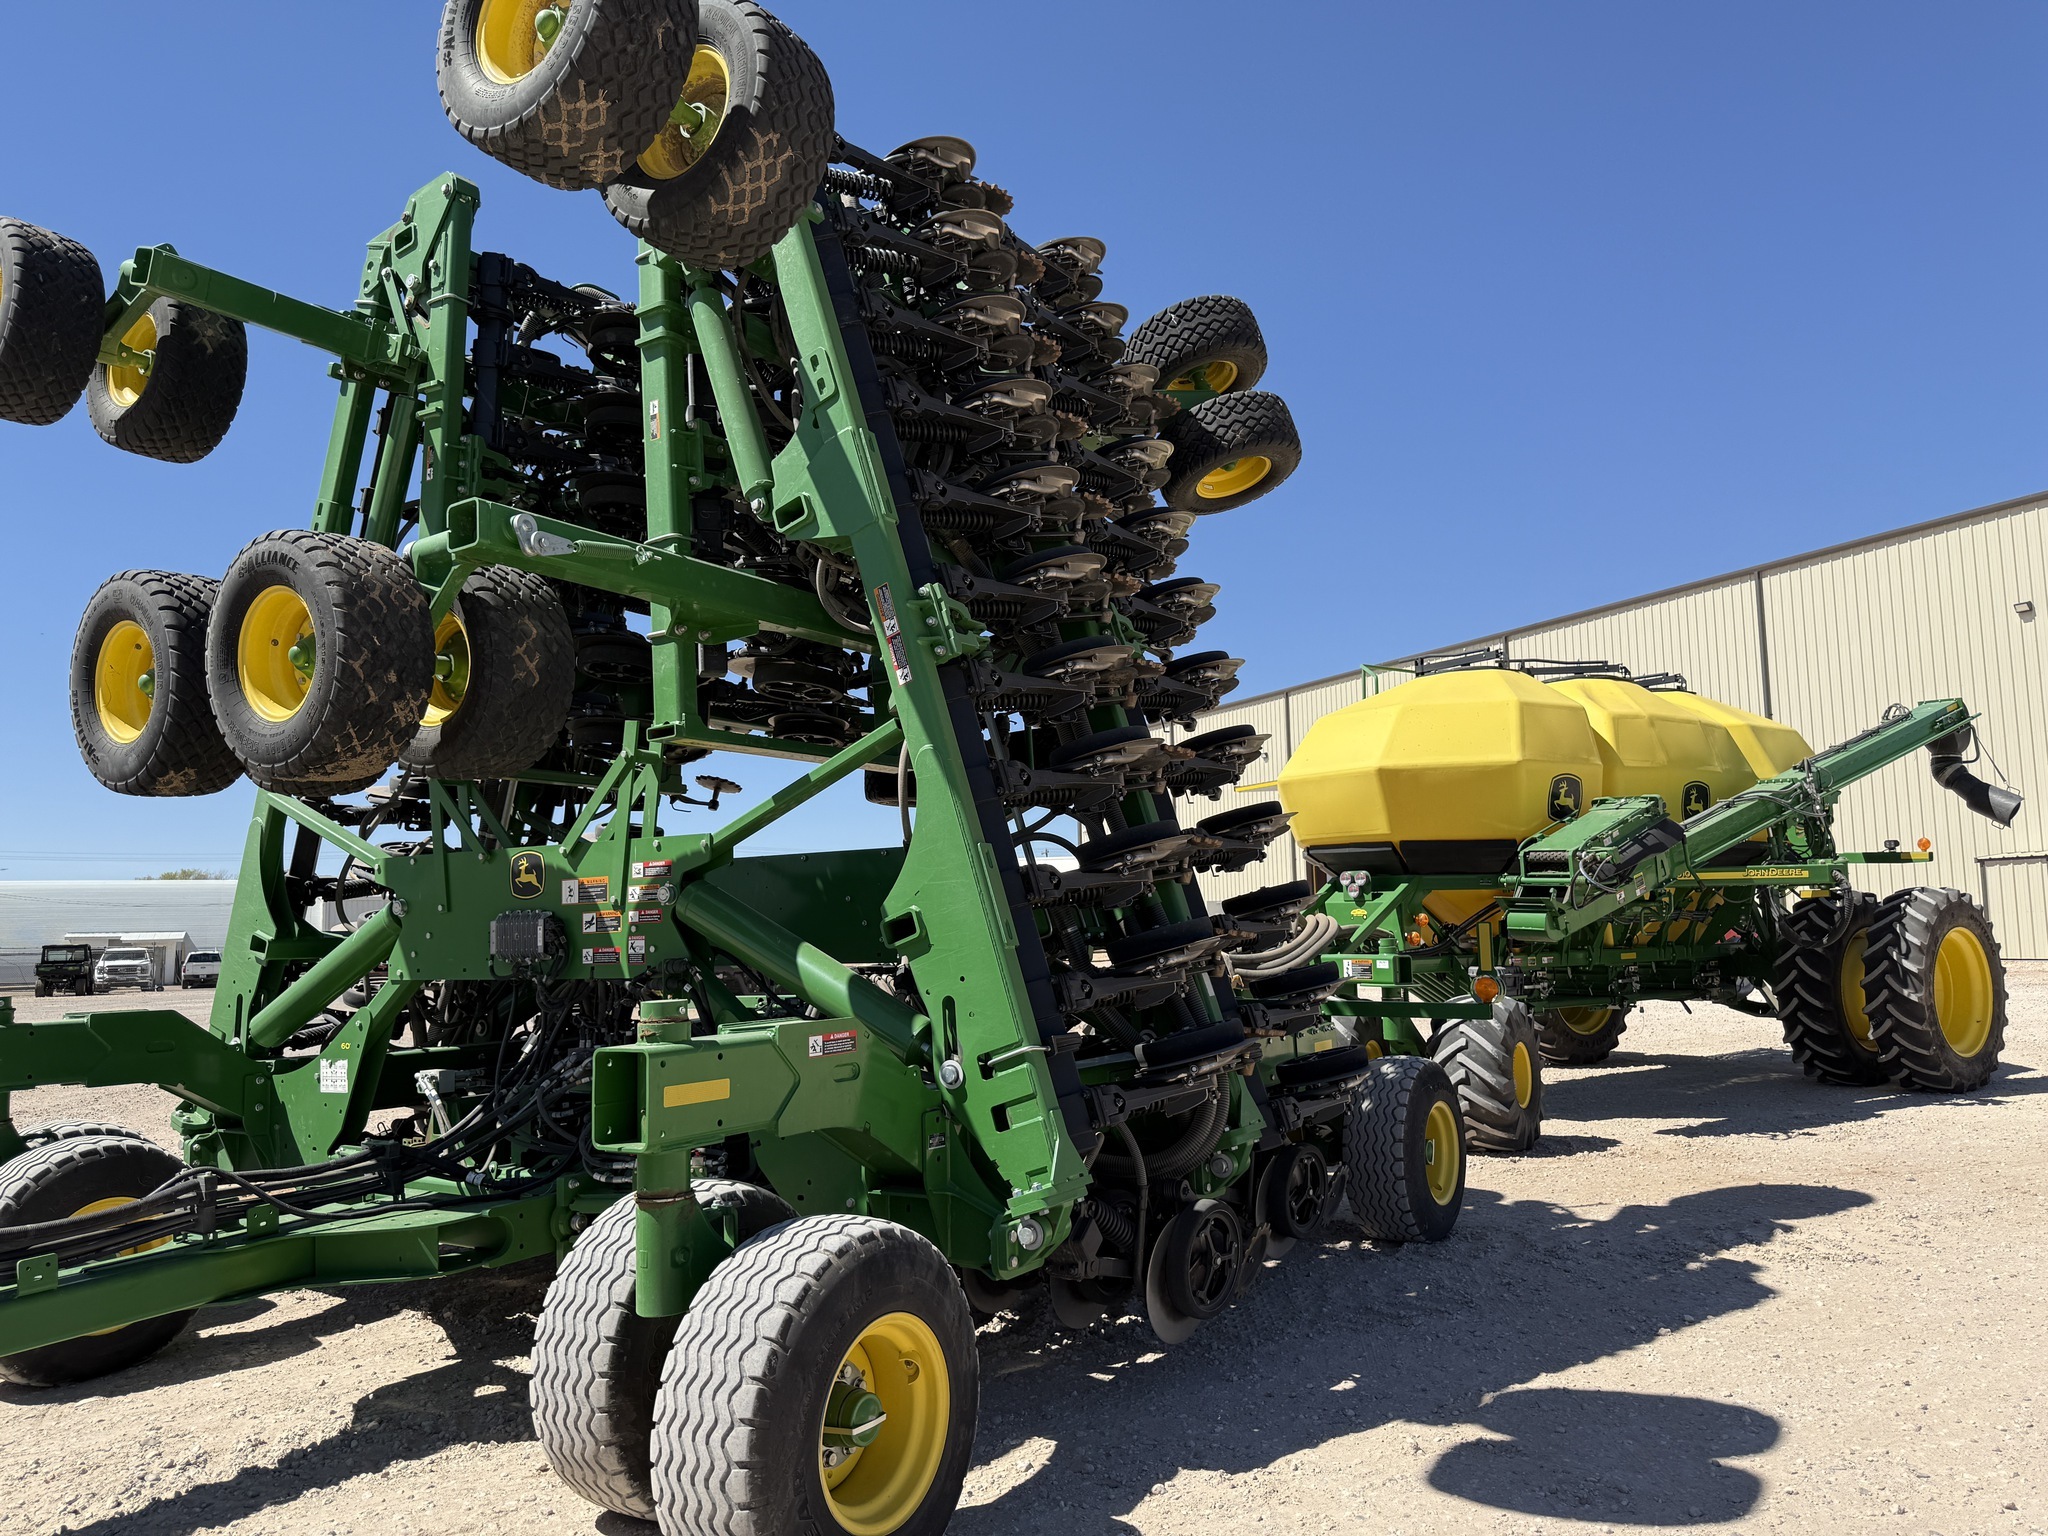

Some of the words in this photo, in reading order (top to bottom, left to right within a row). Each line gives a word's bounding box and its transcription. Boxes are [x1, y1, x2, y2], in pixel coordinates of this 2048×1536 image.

[248, 551, 300, 575] ALLIANCE
[1742, 868, 1769, 877] JOHN
[1769, 868, 1803, 877] DEERE
